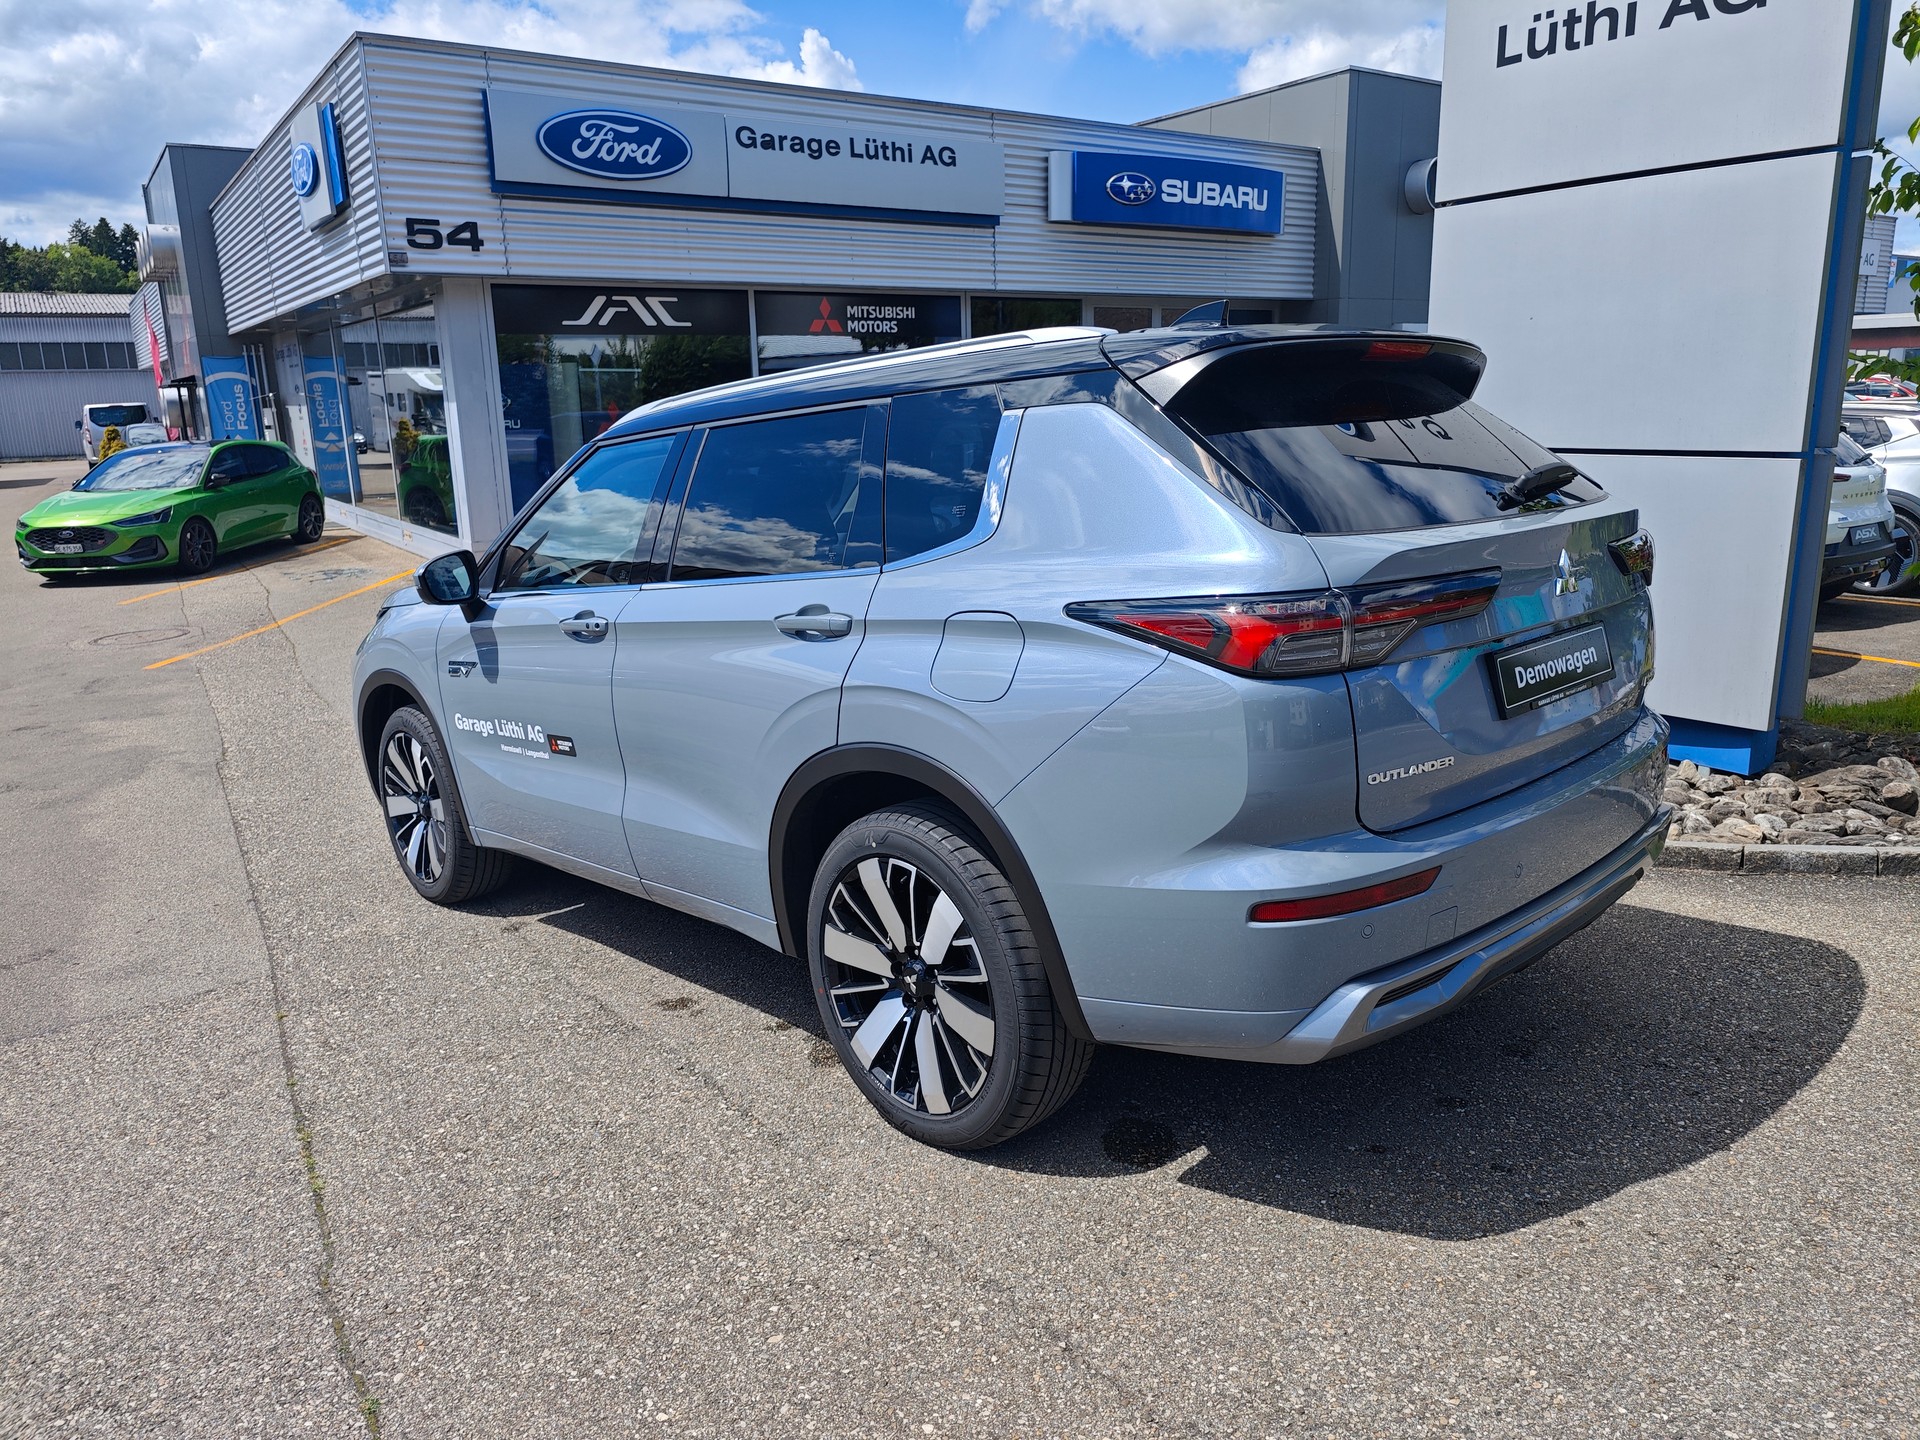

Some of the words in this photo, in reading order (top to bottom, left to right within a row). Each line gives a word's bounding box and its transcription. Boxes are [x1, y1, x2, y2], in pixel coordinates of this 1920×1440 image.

[1496, 0, 1638, 68] Lüthi
[570, 119, 662, 166] Ford
[735, 126, 841, 161] Garage
[849, 136, 914, 165] Lüthi
[920, 144, 957, 168] AG
[1161, 178, 1268, 212] SUBARU
[405, 217, 485, 252] 54
[1863, 253, 1875, 267] AG
[846, 305, 916, 320] MITSUBISHI
[847, 319, 899, 334] MOTORS
[220, 401, 235, 431] Ford
[234, 383, 249, 430] Focus
[1855, 527, 1877, 540] ASX
[1514, 644, 1598, 689] Demowagen
[454, 713, 494, 737] Garage
[494, 719, 525, 740] Lüthi
[527, 724, 544, 743] AG
[1367, 756, 1455, 785] OUTLANDER
